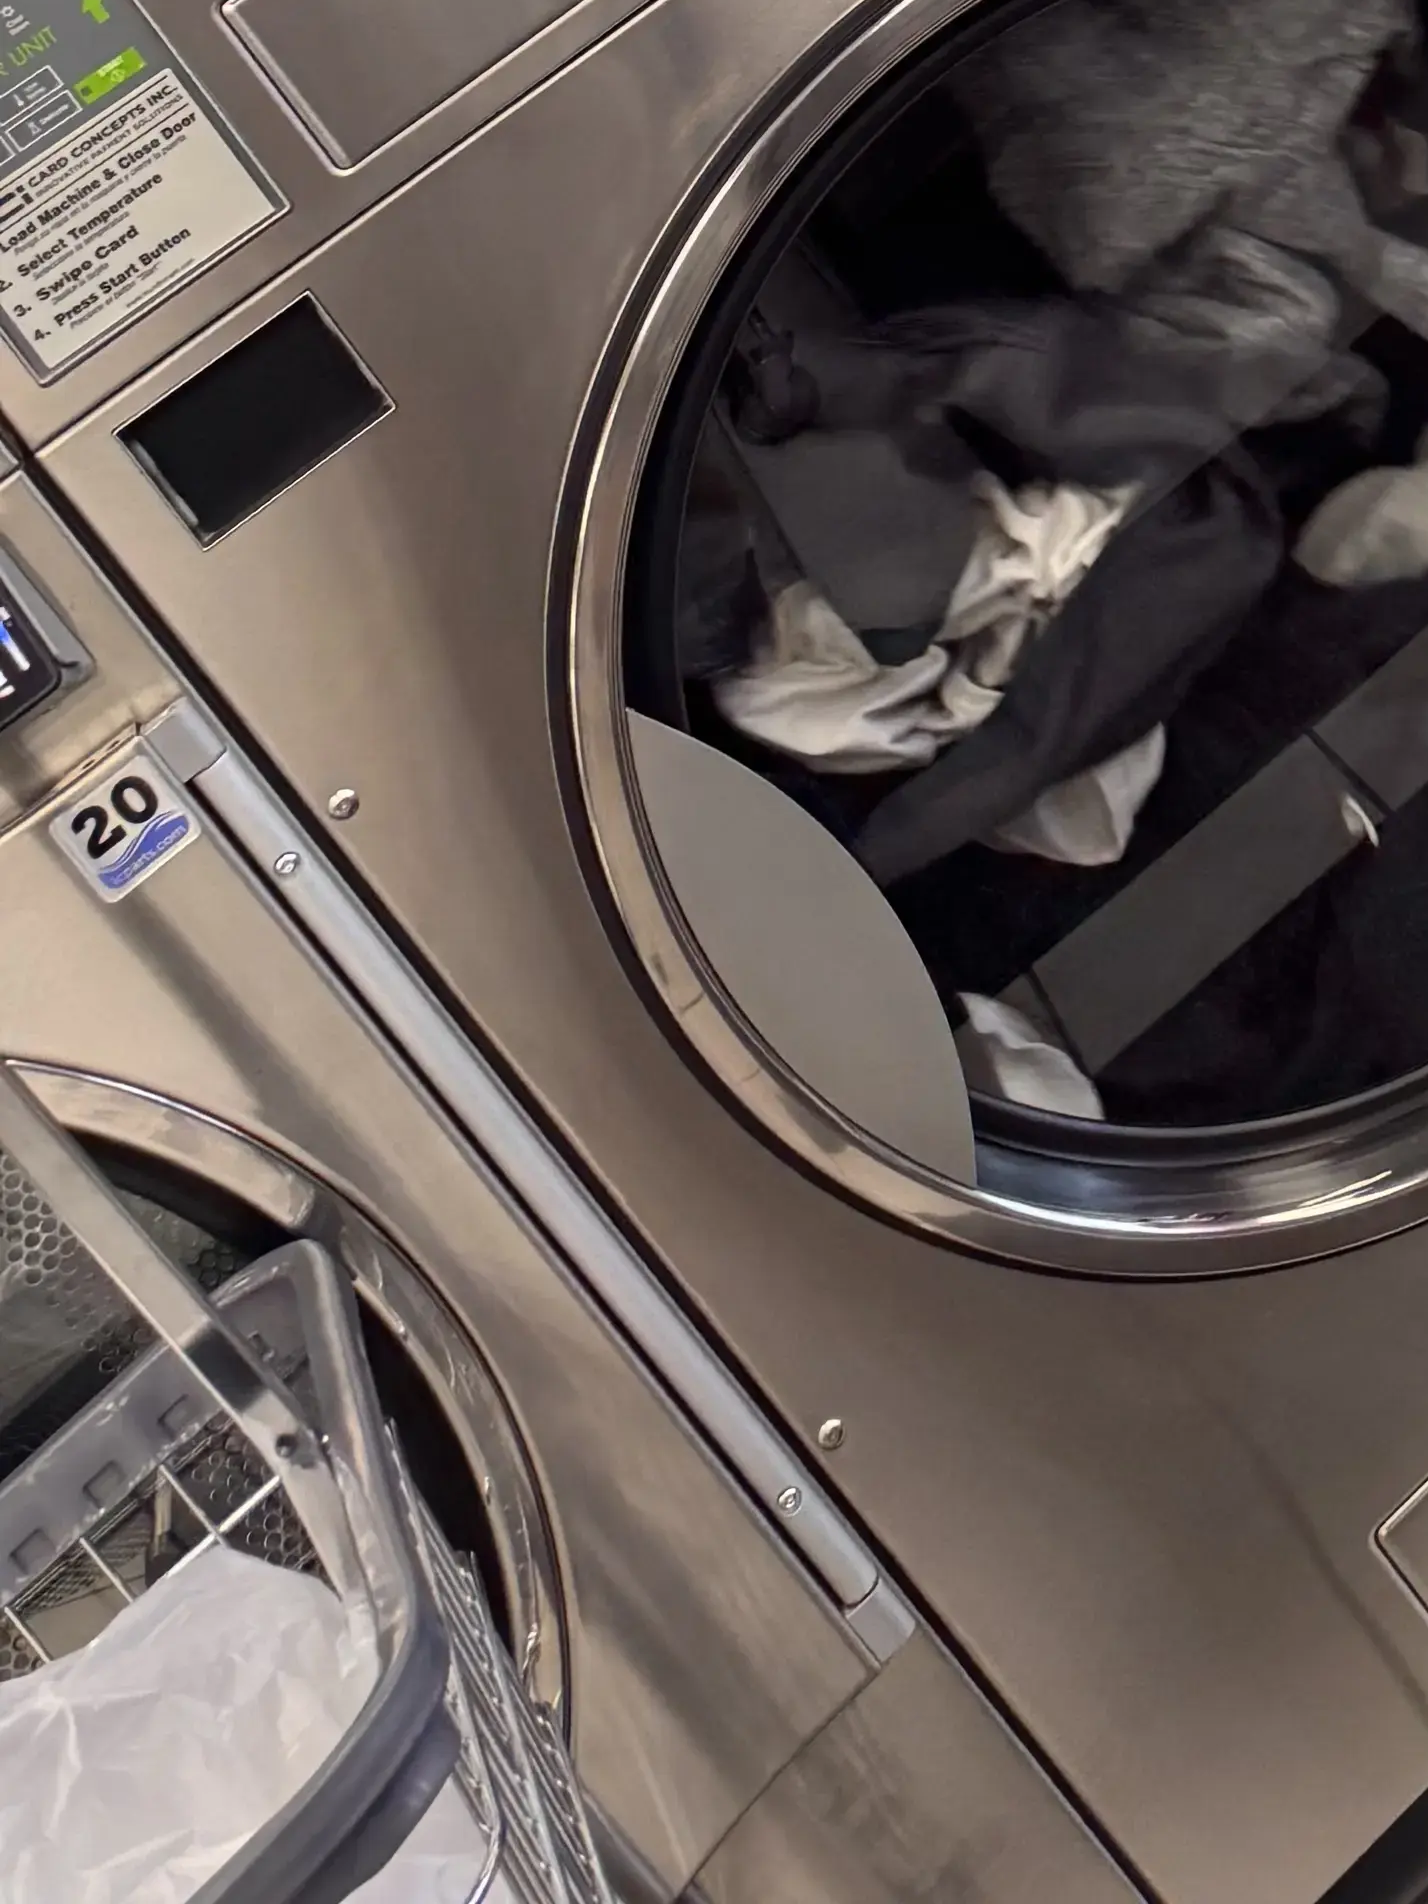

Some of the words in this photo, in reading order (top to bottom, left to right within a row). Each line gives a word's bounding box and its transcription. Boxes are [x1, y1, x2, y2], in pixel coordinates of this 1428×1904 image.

[7, 25, 61, 68] UNIT
[0, 219, 38, 252] Load
[36, 175, 102, 225] Machine
[100, 165, 117, 181] &
[116, 135, 161, 171] Close
[159, 109, 199, 141] Door
[27, 155, 70, 188] CARD
[69, 103, 146, 159] CONCEPTS
[146, 81, 178, 107] INC.
[11, 299, 33, 318] 3.
[33, 255, 96, 304] Swipe
[93, 224, 140, 260] Card
[14, 236, 68, 278] Select
[66, 170, 165, 243] Temperature
[29, 323, 51, 343] 4.
[52, 288, 100, 327] Press
[97, 261, 140, 295] Start
[137, 224, 192, 267] Button
[70, 776, 158, 860] 20
